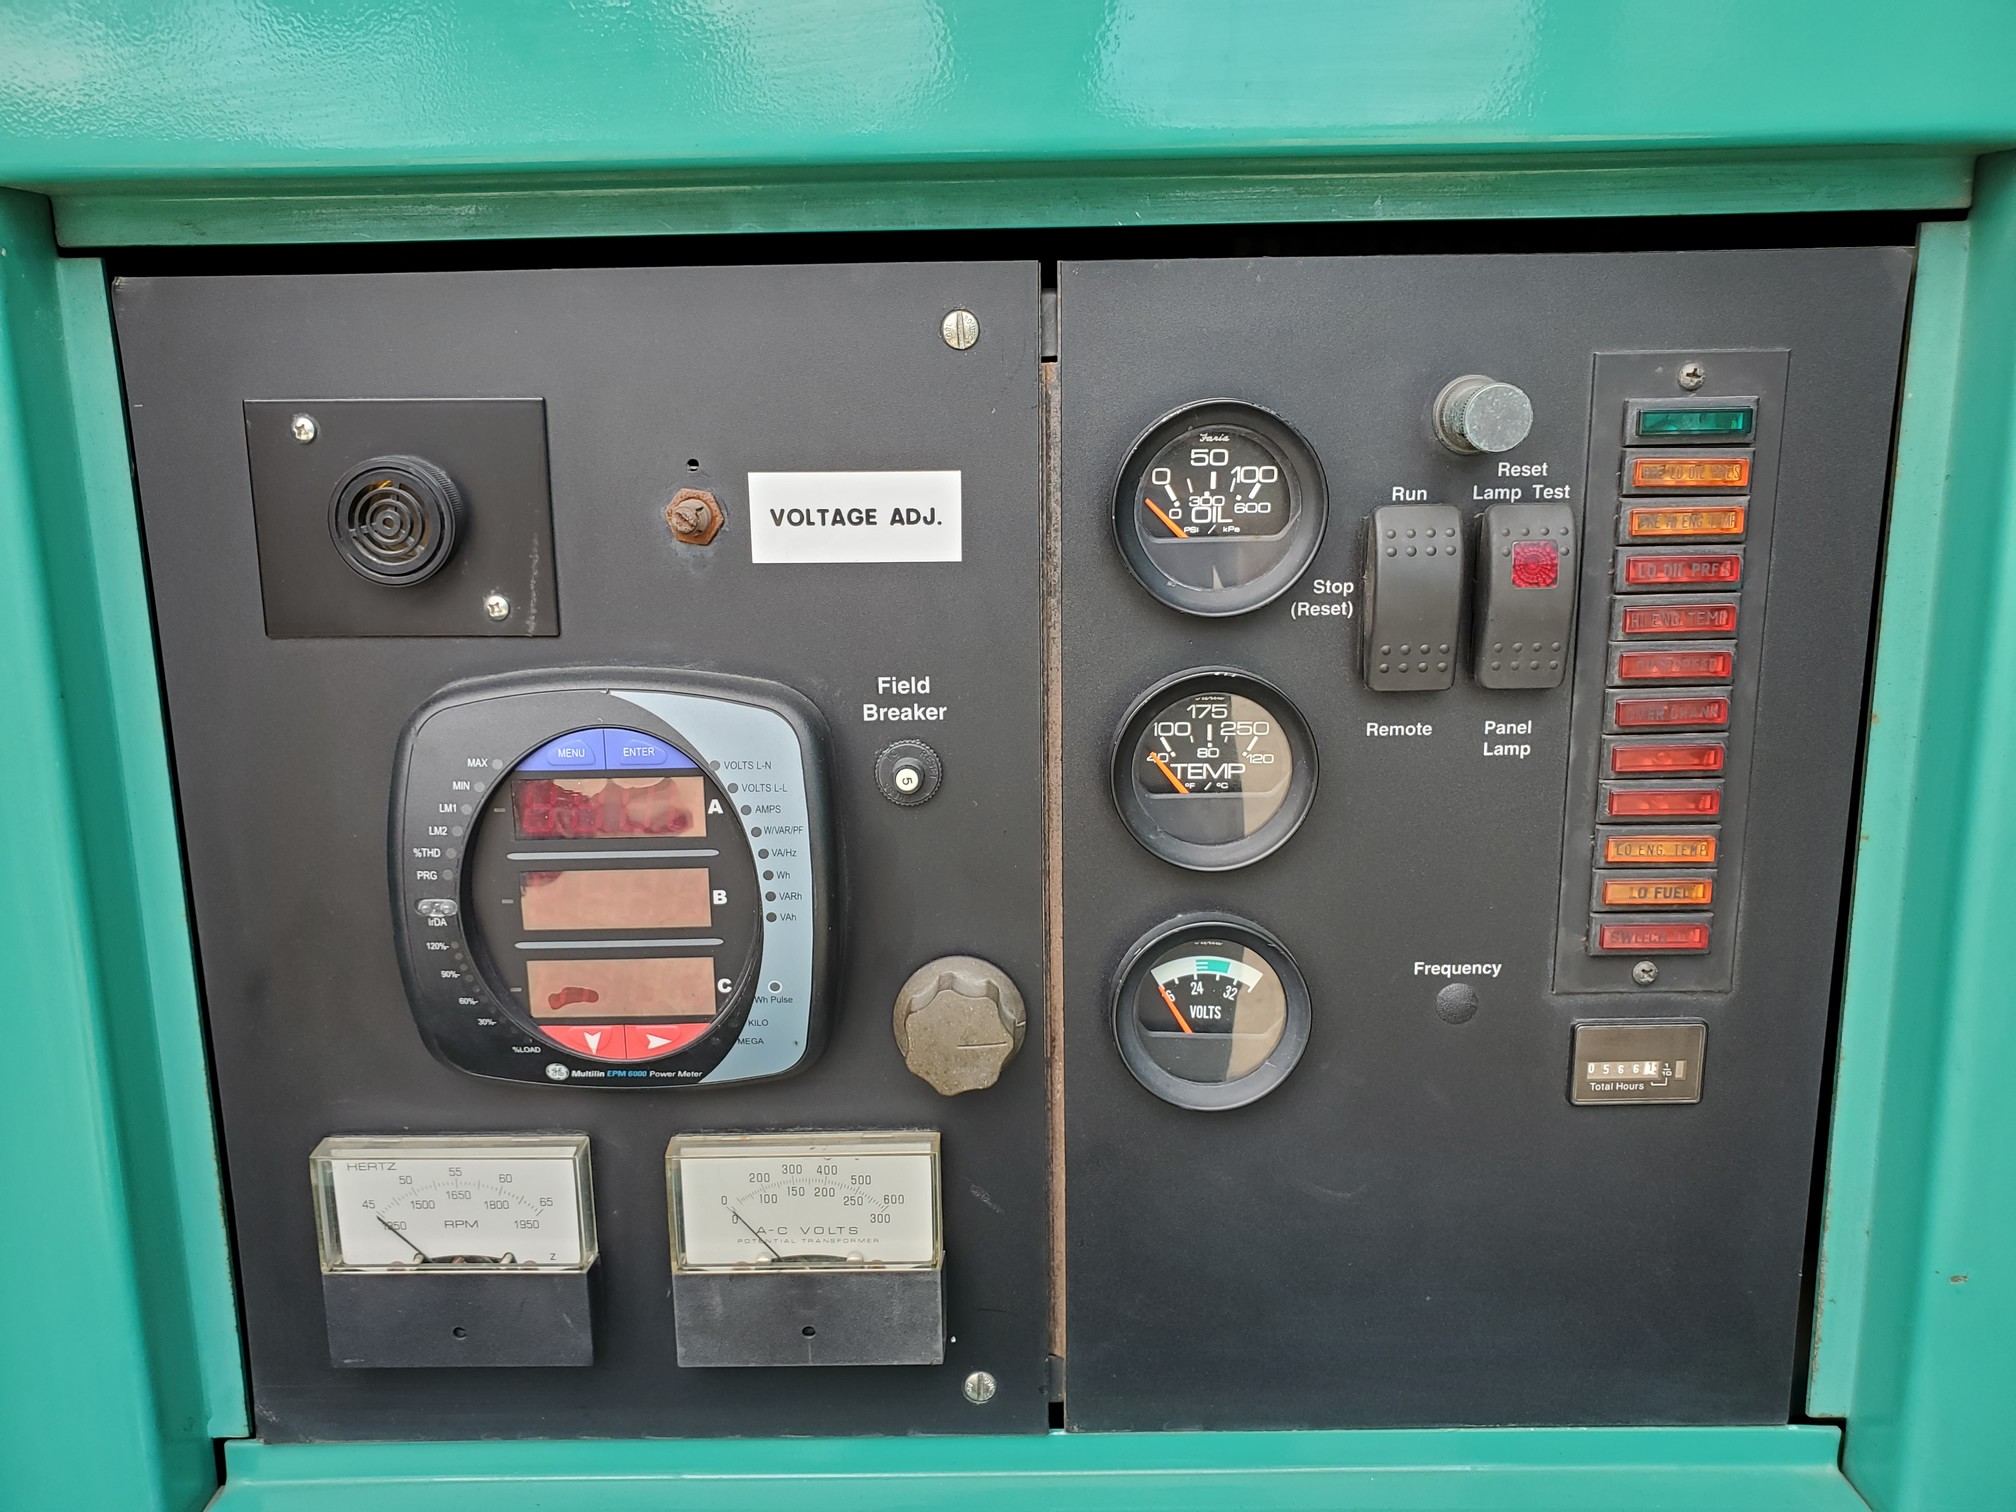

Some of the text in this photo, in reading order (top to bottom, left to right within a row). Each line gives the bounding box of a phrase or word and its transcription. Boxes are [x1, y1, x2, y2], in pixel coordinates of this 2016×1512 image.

[1190, 449, 1229, 466] 50
[1230, 466, 1278, 483] 100
[1498, 462, 1548, 477] Reset
[1152, 468, 1171, 485] 0
[1392, 487, 1428, 501] Run
[1472, 484, 1571, 503] Lamp Test
[1188, 495, 1225, 507] 300
[1168, 508, 1182, 519] 0
[1234, 502, 1271, 514] 600
[770, 507, 943, 526] VOLTAGE ADJ.
[1191, 506, 1233, 523] OIL
[1313, 579, 1355, 597] Stop
[1290, 601, 1354, 619] (Reset)
[877, 676, 930, 695] Field
[863, 703, 947, 721] Breaker
[1186, 703, 1228, 719] 175
[1152, 722, 1191, 737] 100
[1220, 721, 1269, 736] 250
[1366, 722, 1433, 736] Remote
[1484, 720, 1532, 735] Panel
[558, 748, 586, 758] MENU
[623, 747, 656, 757] ENTER
[1196, 747, 1220, 758] 80
[1482, 742, 1531, 758] Lamp
[467, 758, 488, 767] MAX
[1247, 754, 1274, 764] 120
[724, 761, 772, 770] VOLTS L-N
[1170, 763, 1246, 779] TEMP
[452, 781, 470, 790] MIN
[741, 784, 788, 792] VOLTS L-L
[439, 804, 457, 813] LM1
[707, 799, 724, 814] A
[755, 805, 782, 813] AMPS
[428, 826, 448, 835] LM2
[763, 826, 804, 835] W/VAR/PF
[412, 848, 441, 857] %THD
[771, 848, 797, 857] VA/Hz
[416, 870, 438, 880] PRG
[776, 871, 791, 879] Wh
[712, 889, 728, 905] B
[779, 892, 803, 900] VARh
[1653, 885, 1692, 900] FUEL
[780, 913, 797, 921] VAh
[1414, 961, 1502, 978] Frequency
[717, 978, 732, 994] C
[1190, 981, 1204, 995] 24
[1222, 985, 1238, 1000] 32
[753, 995, 793, 1004] Wh Pulse
[1189, 1005, 1222, 1019] VOLTS
[748, 1019, 769, 1027] KILO
[737, 1037, 764, 1045] MEGA
[649, 1070, 676, 1078] Power
[677, 1070, 703, 1078] Meter
[1589, 1082, 1645, 1091] Total Hours
[347, 1162, 397, 1171] HERTZ
[448, 1167, 462, 1177] 55
[781, 1164, 803, 1175] 300
[816, 1165, 838, 1176] 400
[399, 1175, 413, 1185] 50
[498, 1173, 513, 1184] 60
[749, 1172, 770, 1183] 200
[850, 1174, 872, 1186] 500
[445, 1190, 471, 1200] 1650
[787, 1186, 805, 1197] 150
[814, 1187, 836, 1198] 200
[539, 1197, 554, 1207] 65
[721, 1195, 728, 1206] 0
[759, 1193, 778, 1204] 100
[843, 1195, 864, 1206] 250
[883, 1194, 905, 1205] 600
[362, 1200, 376, 1210] 45
[410, 1200, 436, 1210] 1500
[484, 1200, 510, 1210] 1800
[731, 1214, 739, 1224] 0
[869, 1213, 891, 1224] 300
[444, 1220, 479, 1229] RPM
[513, 1219, 540, 1230] 1950
[756, 1226, 859, 1235] A-C VOLTS
